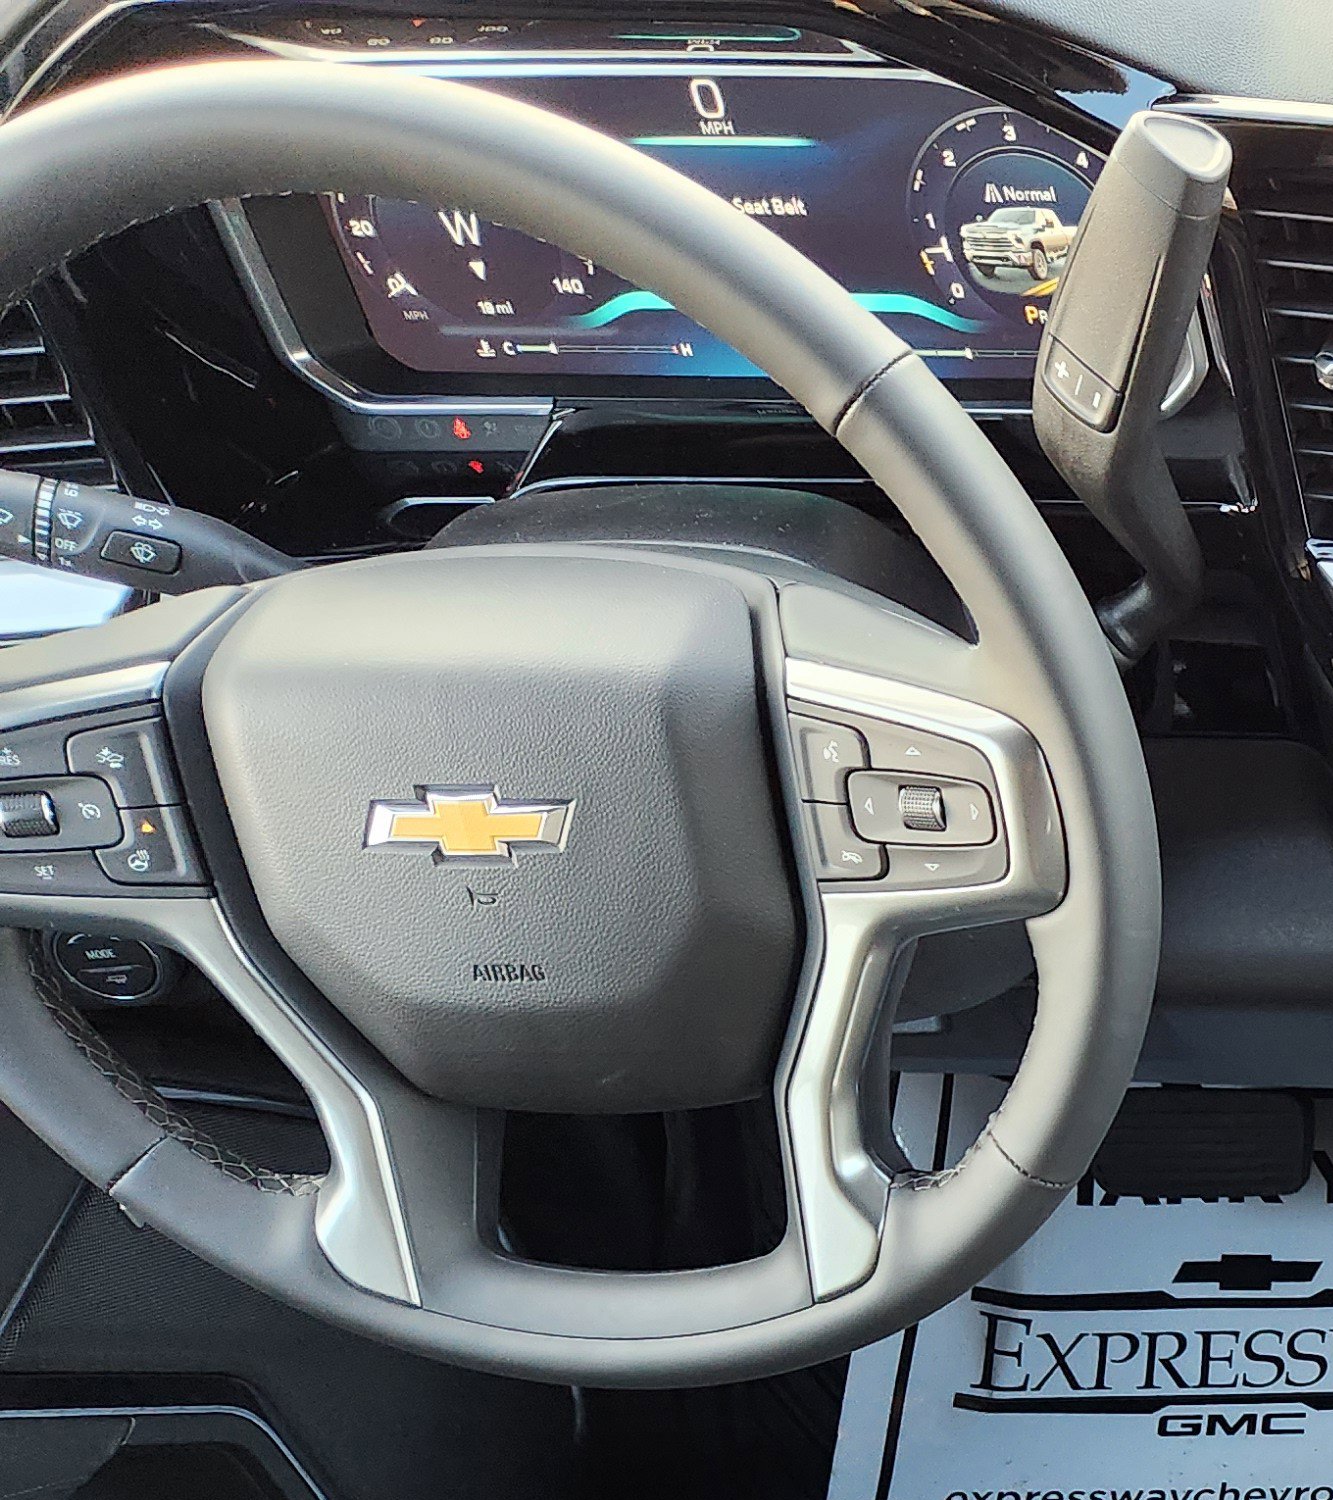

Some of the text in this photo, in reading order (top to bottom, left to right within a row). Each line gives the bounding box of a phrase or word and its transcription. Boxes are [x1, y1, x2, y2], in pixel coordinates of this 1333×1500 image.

[690, 78, 725, 119] 0
[700, 121, 735, 135] MPH
[942, 150, 957, 167] 2
[1002, 185, 1058, 203] Normal
[732, 197, 807, 216] Seat Belt
[349, 219, 376, 237] 20
[438, 210, 482, 246] W
[552, 279, 585, 295] 140
[402, 310, 429, 320] MPH
[55, 537, 77, 552] OFF
[34, 865, 55, 877] SET
[85, 949, 117, 960] MODE
[473, 963, 546, 983] AIRBAG
[1157, 1412, 1307, 1437] GMC
